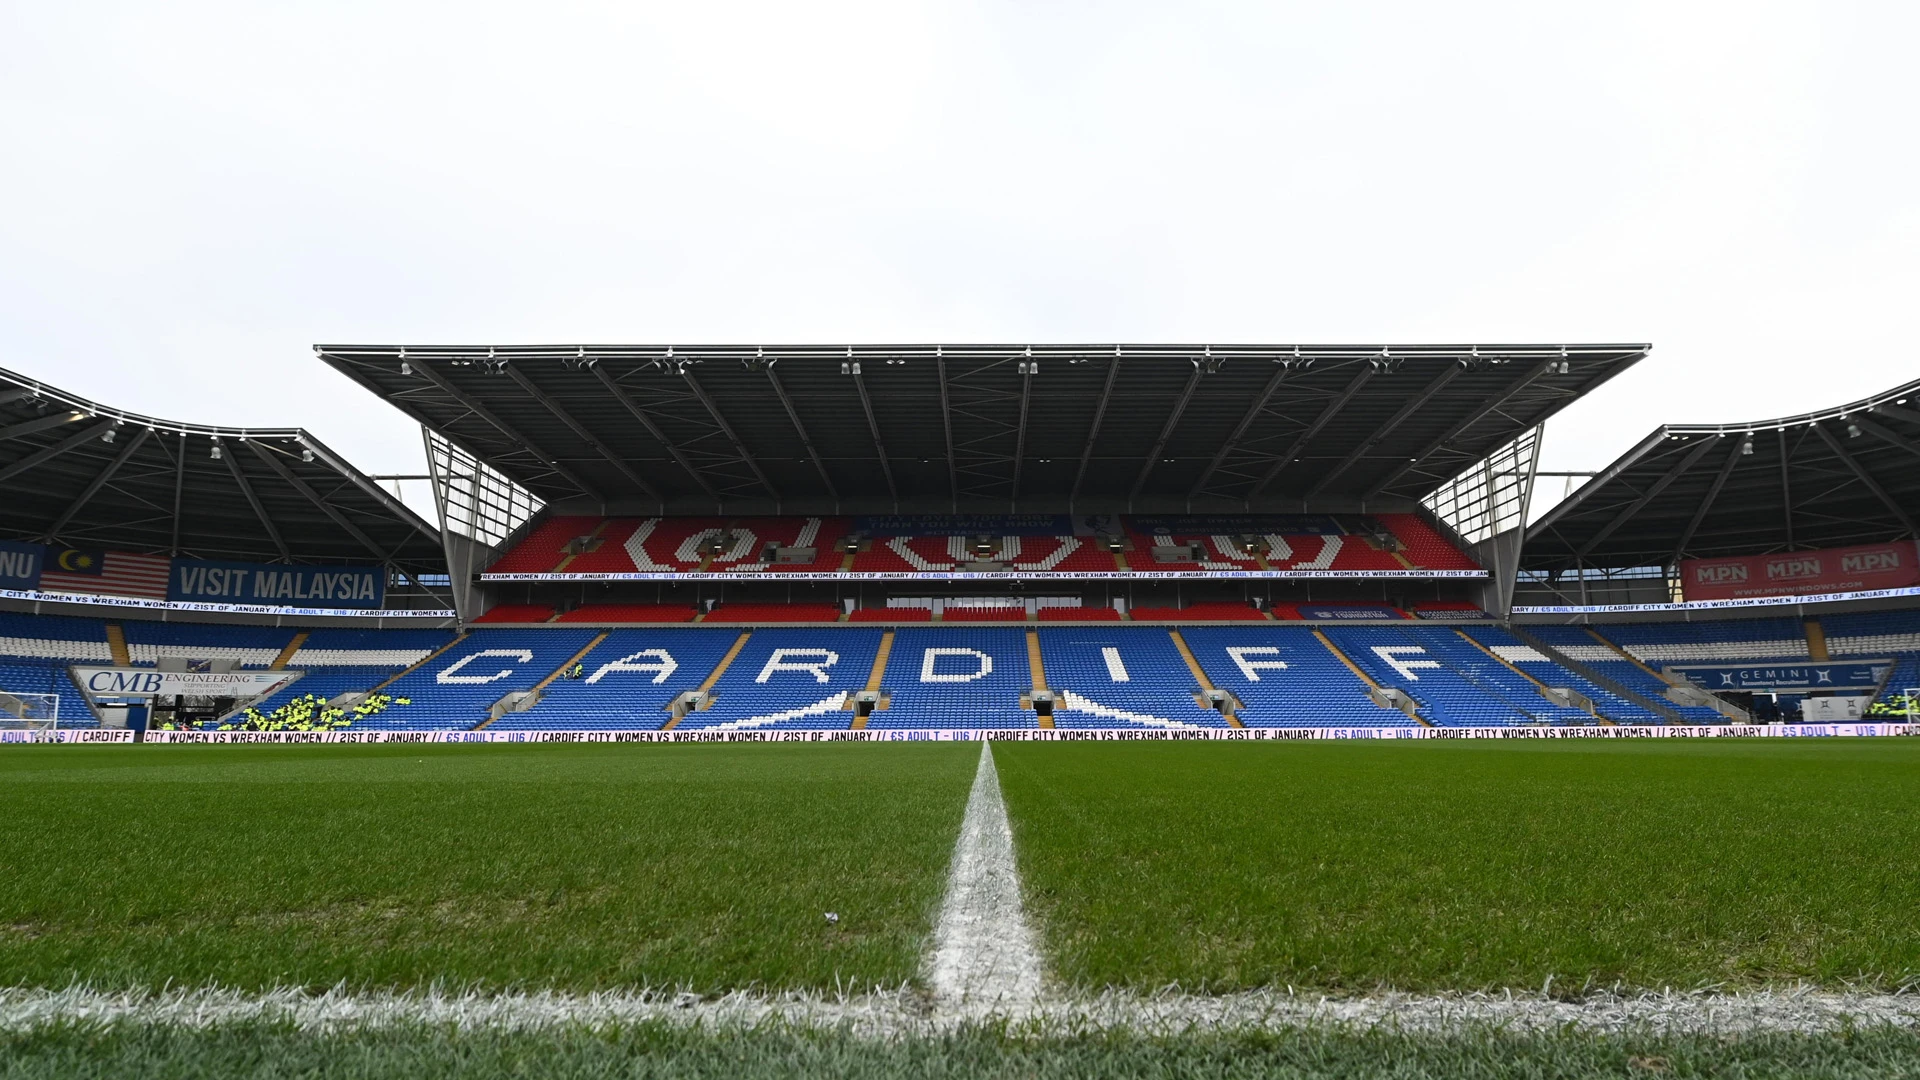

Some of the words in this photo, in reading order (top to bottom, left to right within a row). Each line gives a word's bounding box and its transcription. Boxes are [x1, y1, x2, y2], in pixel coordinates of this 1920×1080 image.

[0, 551, 34, 579] NU
[181, 567, 248, 597] VISIT
[254, 571, 375, 600] MALAYSIA
[34, 593, 72, 602] WOMEN
[92, 597, 141, 606] WREXHAM
[1664, 602, 1695, 610] WOMEN
[1849, 590, 1891, 599] JANUARY
[436, 646, 1441, 684] CARDIFF
[1740, 669, 1808, 679] GEMINI
[88, 671, 163, 693] CMB
[165, 674, 250, 683] ENGINEERING
[2, 732, 35, 742] ADULT
[83, 732, 131, 742] CARDIFF
[145, 732, 166, 742] CITY
[169, 732, 210, 742] WOMEN
[213, 732, 226, 742] VS
[230, 733, 281, 743] WREXHAM
[285, 733, 322, 743] WOMEN
[340, 732, 364, 743] 21ST
[368, 732, 380, 743] OF
[384, 732, 429, 742] JANUARY
[463, 732, 497, 742] ADULT
[509, 732, 526, 742] U16
[542, 732, 585, 742] CARDIFF
[588, 732, 612, 742] CITY
[615, 732, 654, 742] WOMEN
[657, 732, 670, 742] VS
[674, 732, 724, 742] WREXHAM
[728, 732, 766, 742] WOMEN
[784, 732, 808, 741] 21ST
[811, 732, 824, 741] OF
[828, 732, 873, 741] JANUARY
[908, 731, 941, 741] ADULT
[953, 731, 970, 741] U16
[987, 731, 1029, 740] CARDIFF
[1033, 731, 1056, 740] CITY
[1059, 730, 1097, 740] WOMEN
[1101, 730, 1114, 740] VS
[1117, 730, 1169, 740] WREXHAM
[1172, 730, 1210, 739] WOMEN
[1227, 730, 1251, 739] 21ST
[1255, 729, 1268, 739] OF
[1271, 729, 1316, 739] JANUARY
[1351, 729, 1384, 739] ADULT
[1396, 729, 1413, 739] U16
[1430, 729, 1471, 738] CARDIFF
[1475, 728, 1498, 738] CITY
[1501, 728, 1540, 738] WOMEN
[1543, 728, 1556, 738] VS
[1559, 728, 1610, 738] WREXHAM
[1613, 727, 1652, 737] WOMEN
[1670, 727, 1694, 737] 21ST
[1699, 727, 1712, 737] OF
[1717, 727, 1762, 737] JANUARY
[1801, 726, 1839, 736] ADULT
[1856, 726, 1876, 736] U16
